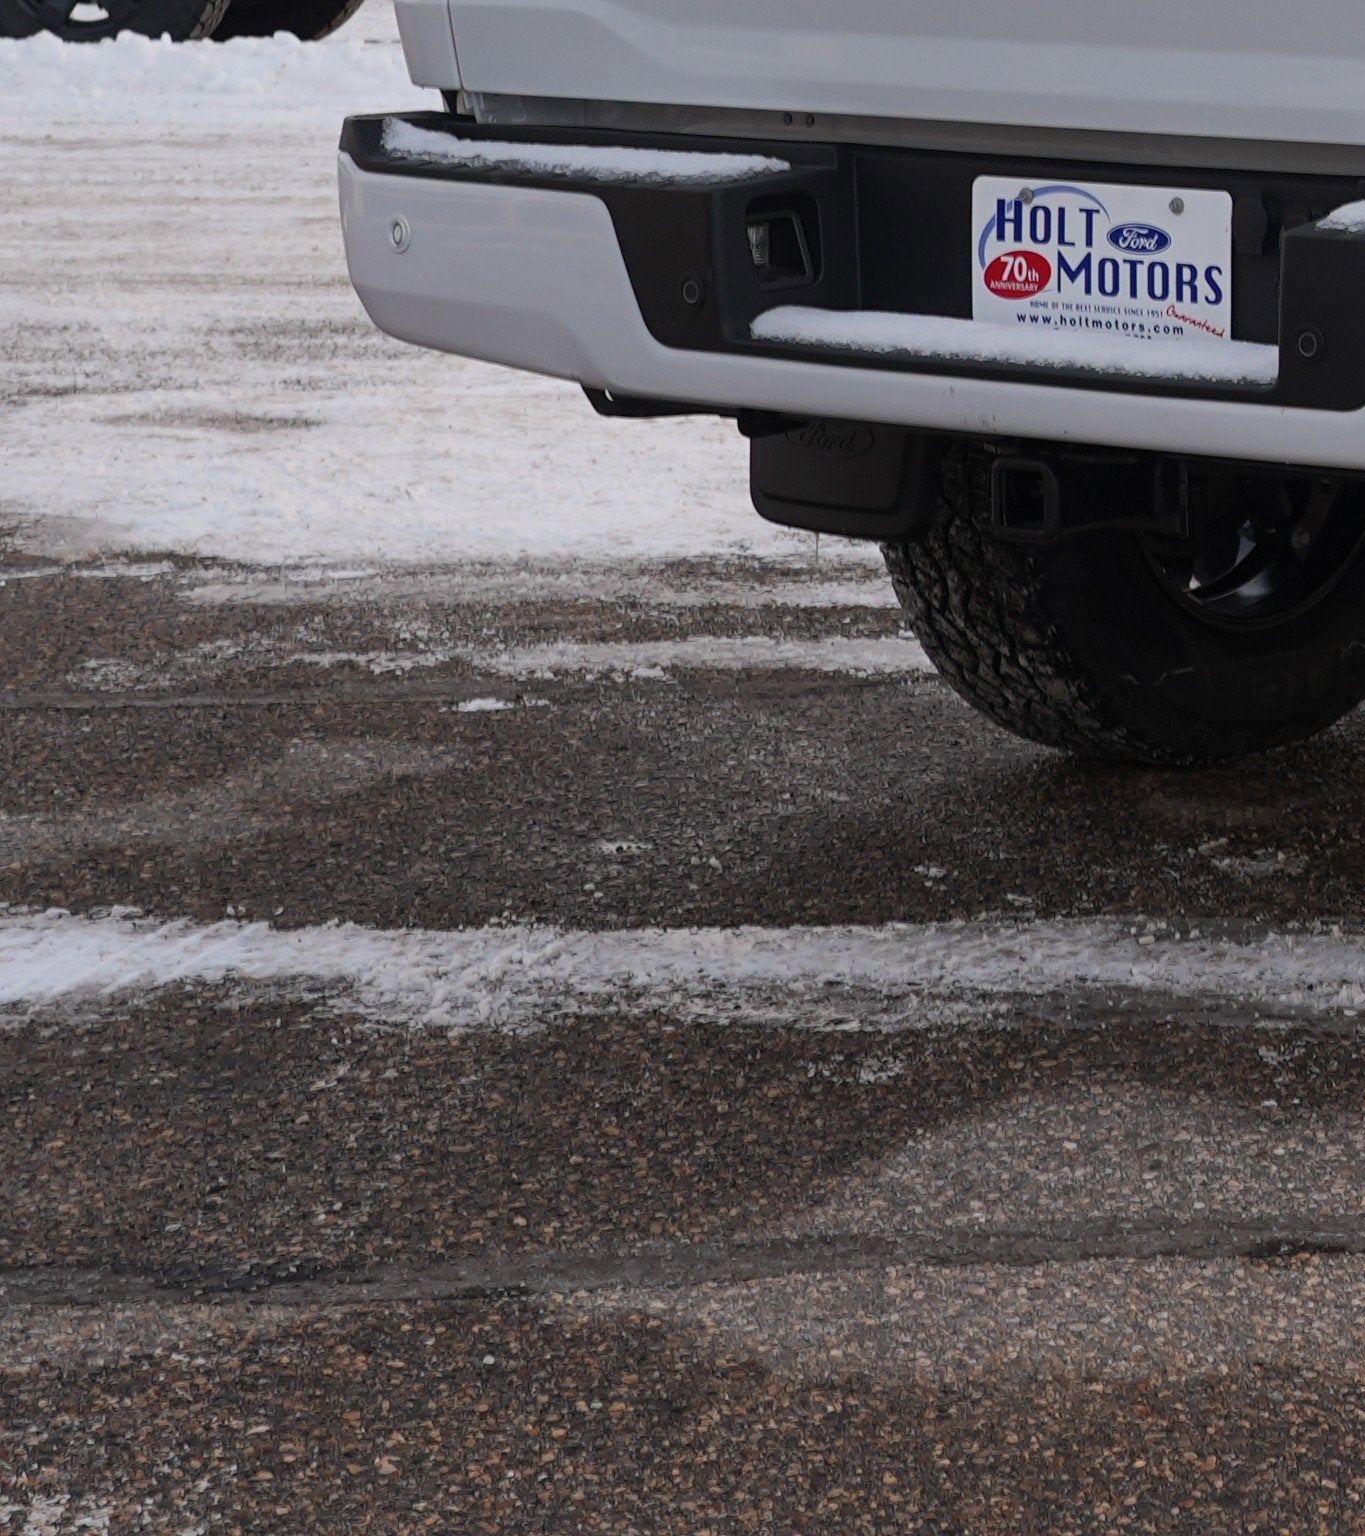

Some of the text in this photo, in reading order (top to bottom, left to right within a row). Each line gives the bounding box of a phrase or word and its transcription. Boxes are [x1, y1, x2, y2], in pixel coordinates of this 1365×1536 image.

[996, 197, 1101, 248] HOLT
[1116, 226, 1159, 252] Ford
[1000, 255, 1040, 282] 70th
[1056, 249, 1224, 306] MOTORS
[989, 279, 1039, 293] ANNIVERSARY
[1016, 312, 1185, 337] www.holtmotors.com
